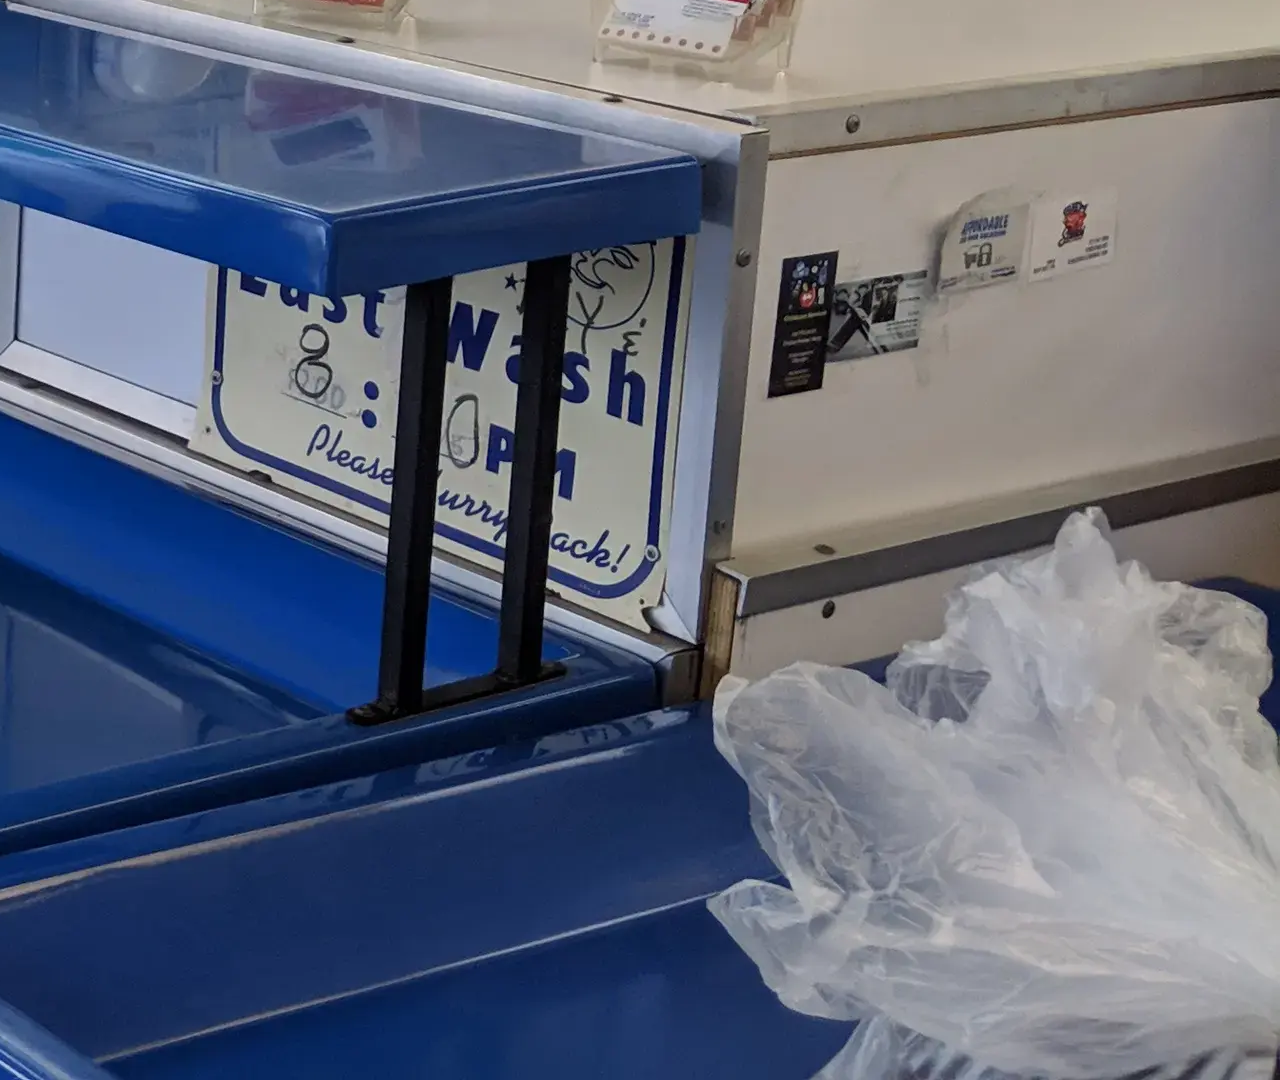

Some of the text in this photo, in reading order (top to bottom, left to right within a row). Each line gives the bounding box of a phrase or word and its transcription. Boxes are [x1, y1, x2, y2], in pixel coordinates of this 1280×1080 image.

[307, 423, 632, 574] Please urry ack!
